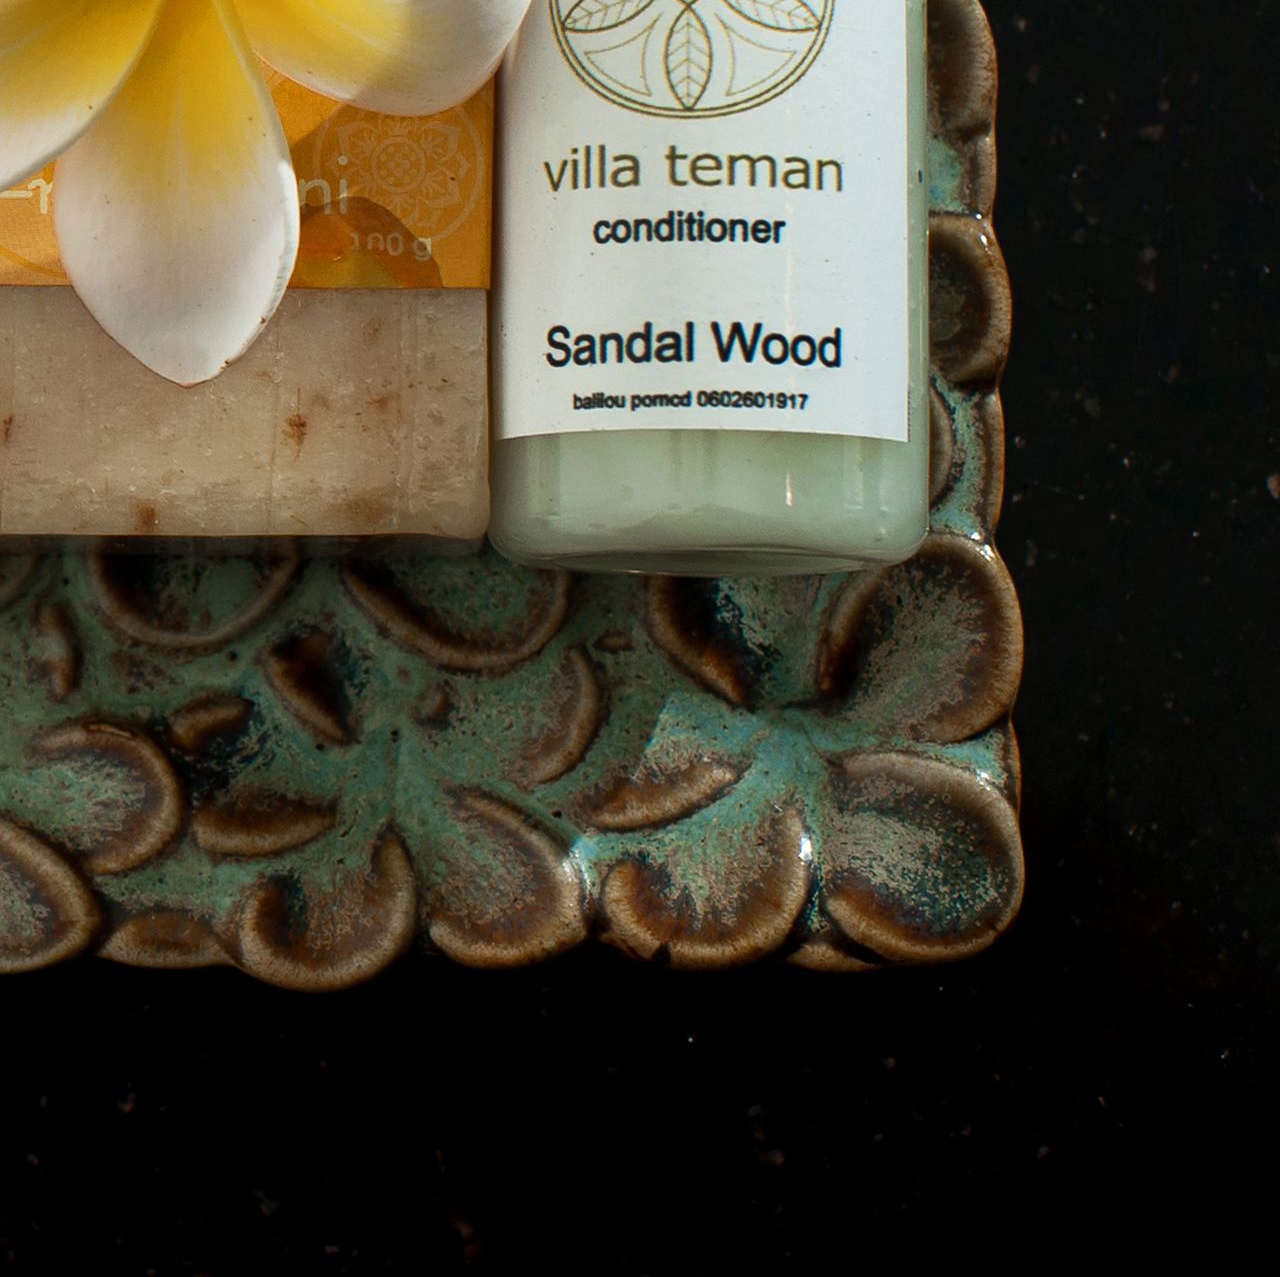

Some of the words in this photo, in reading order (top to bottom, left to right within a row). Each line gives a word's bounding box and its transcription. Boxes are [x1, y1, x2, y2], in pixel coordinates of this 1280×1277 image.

[543, 143, 642, 193] villa
[665, 144, 843, 193] teman
[592, 209, 787, 245] conditioner
[545, 321, 696, 369] Sandal
[710, 320, 843, 369] Wood
[695, 389, 810, 411] 0602601917
